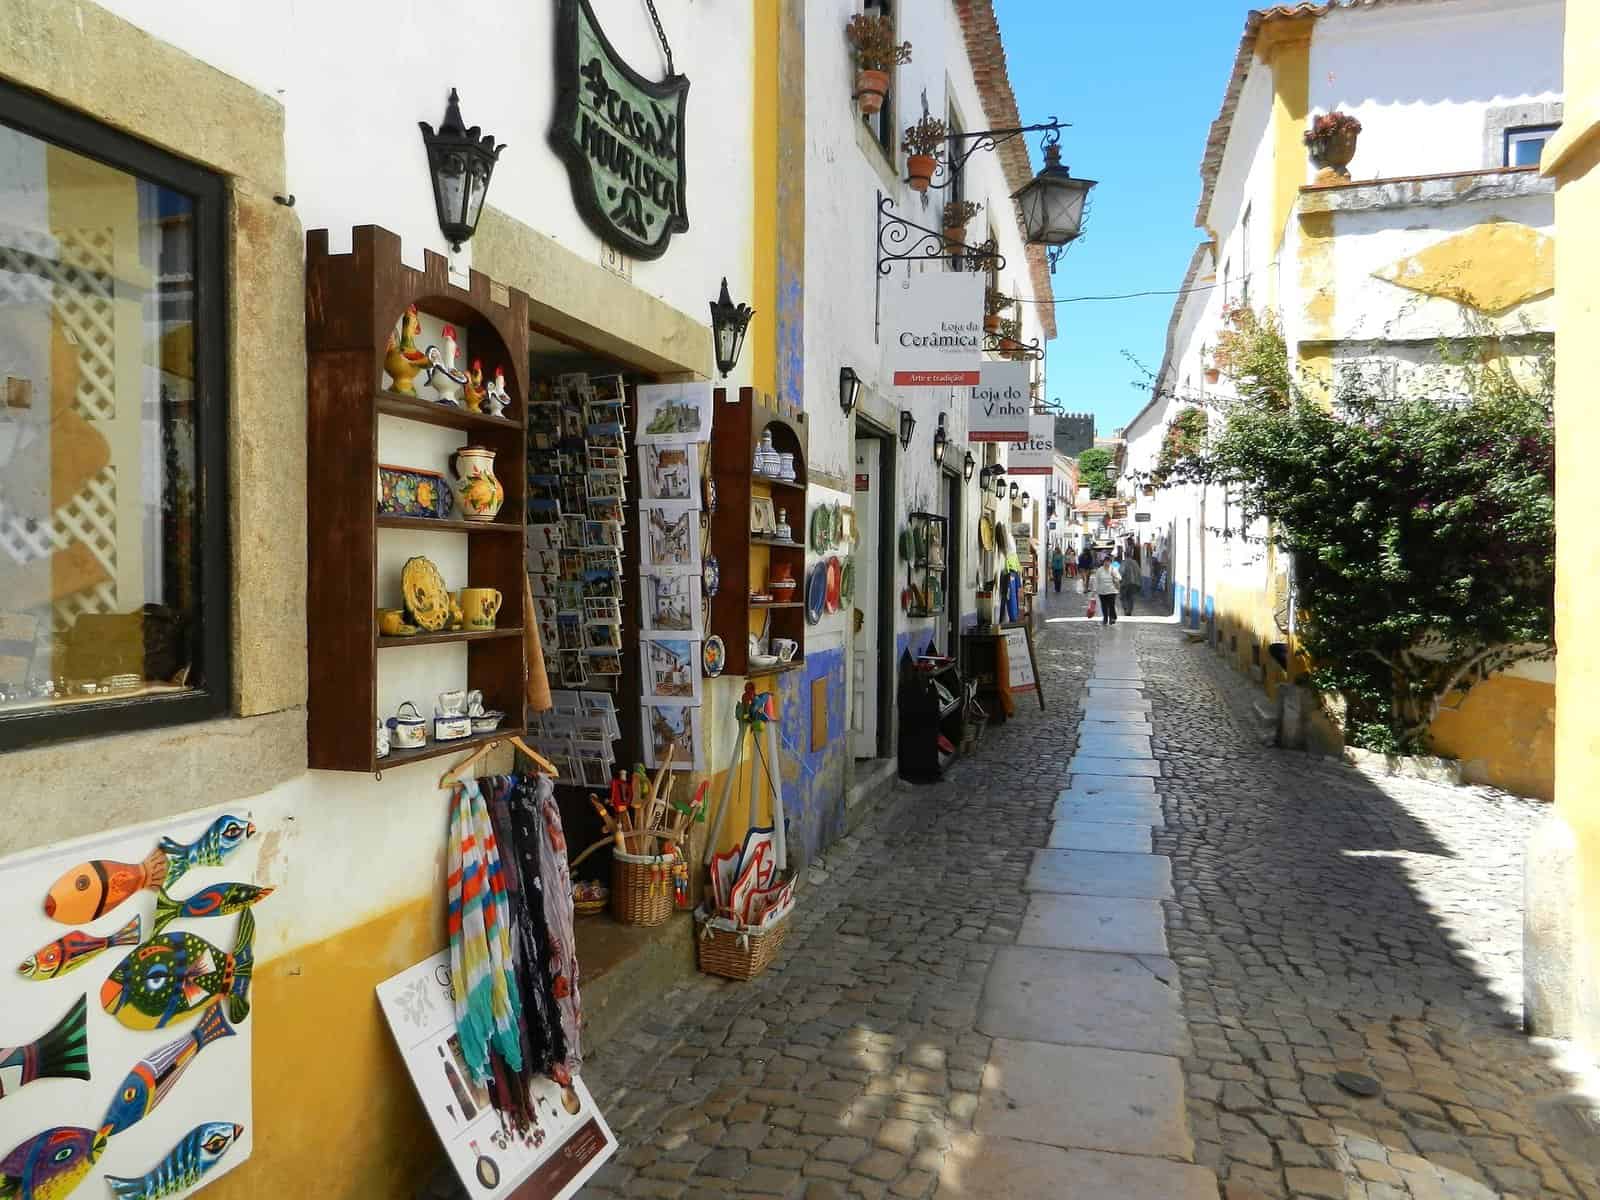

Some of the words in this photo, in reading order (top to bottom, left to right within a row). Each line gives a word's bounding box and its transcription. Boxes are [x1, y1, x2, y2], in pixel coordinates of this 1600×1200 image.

[580, 112, 677, 215] MOURISCA
[941, 321, 963, 334] Loja
[965, 321, 978, 331] da
[899, 331, 977, 347] Cerâmica
[972, 387, 999, 402] Loja
[1003, 385, 1021, 399] do
[1010, 439, 1053, 451] Artes
